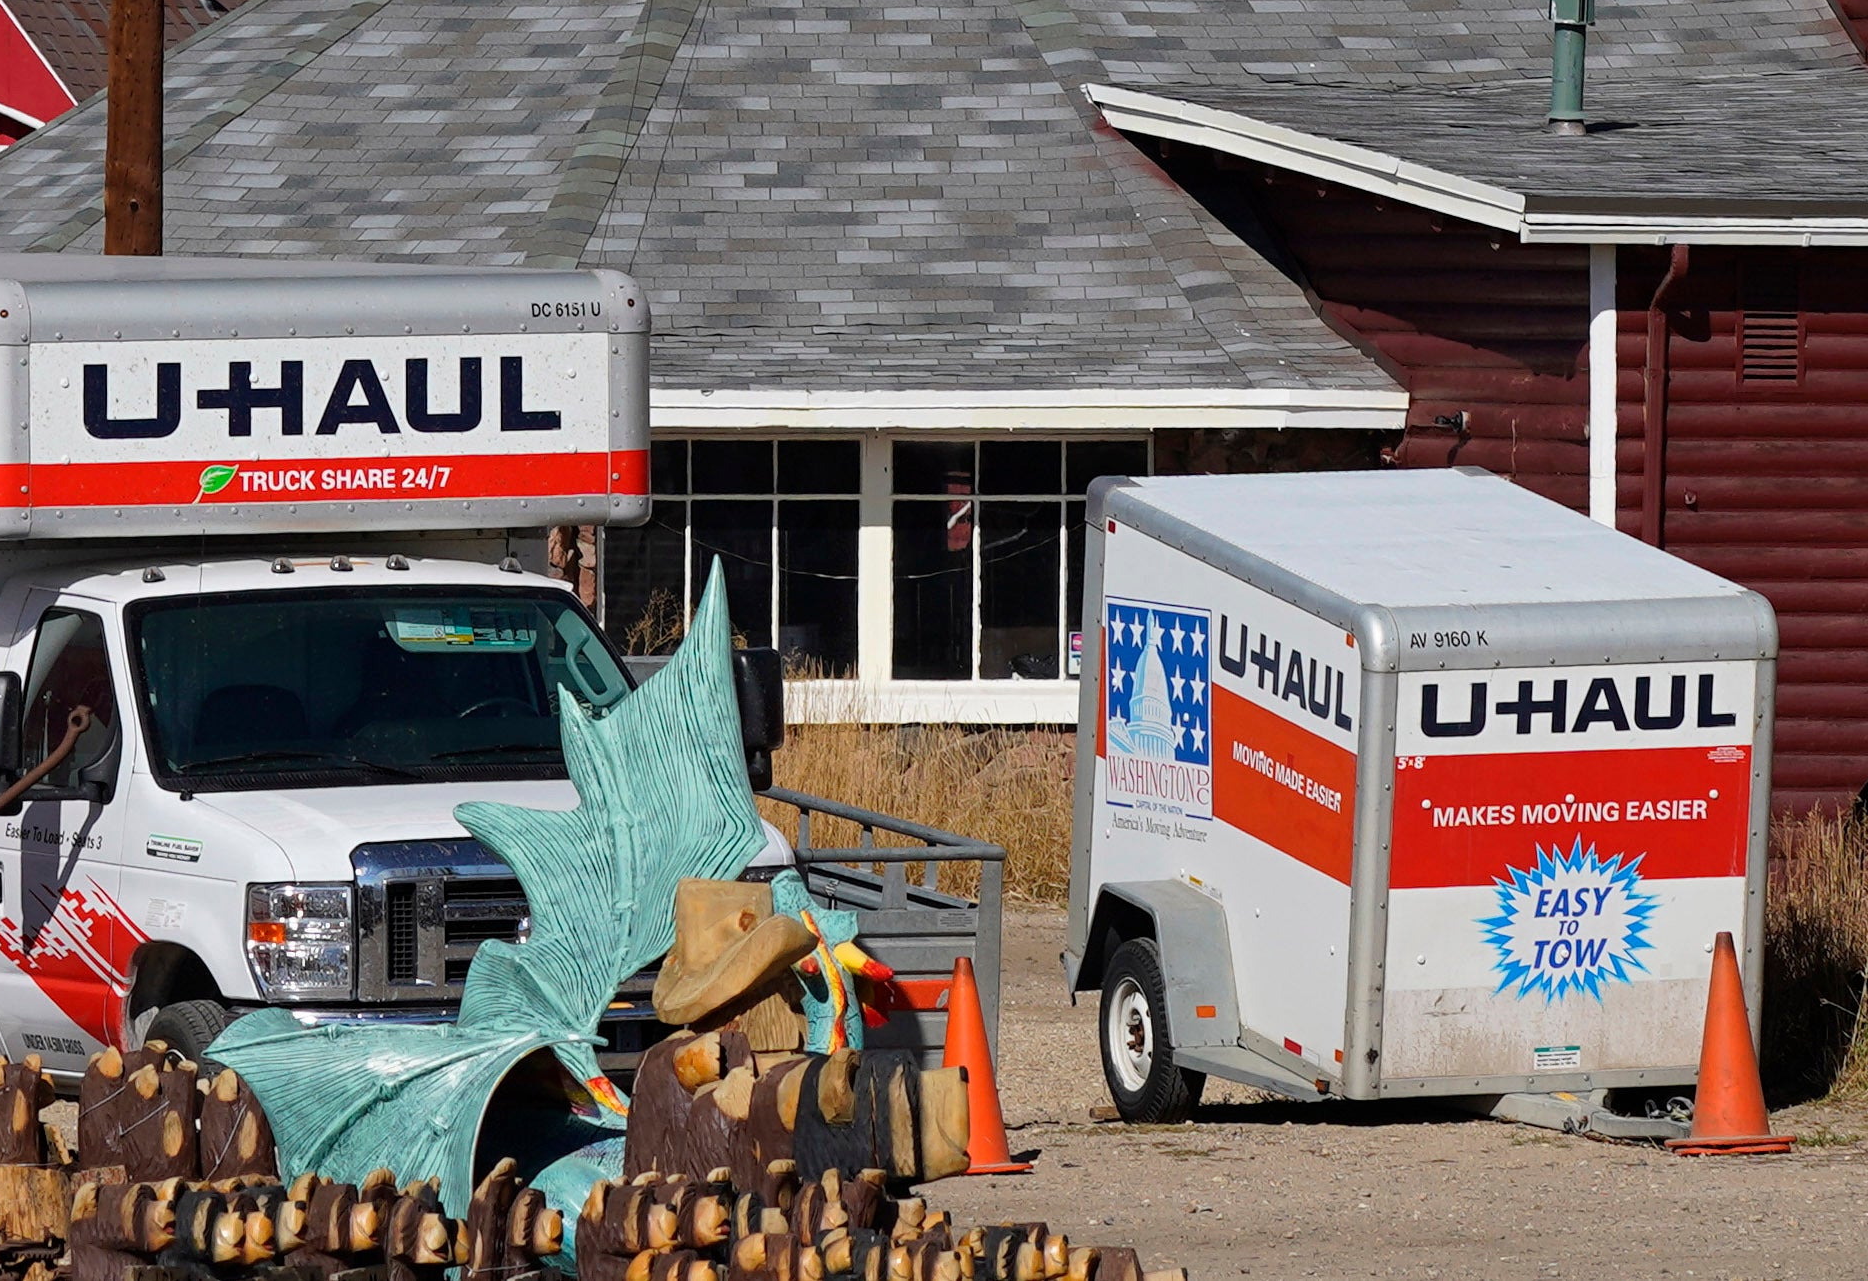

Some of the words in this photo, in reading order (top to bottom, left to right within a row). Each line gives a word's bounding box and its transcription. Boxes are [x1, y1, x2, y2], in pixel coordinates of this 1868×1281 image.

[531, 303, 552, 317] DC
[556, 302, 586, 317] 6151
[591, 302, 601, 316] U
[83, 357, 561, 440] U-HAUL
[238, 469, 316, 492] TRUCK
[321, 467, 396, 490] SHARE
[401, 465, 451, 490] 24/7
[1410, 631, 1428, 649] AV
[1434, 630, 1471, 648] 9160
[1476, 629, 1489, 646] K
[1219, 614, 1353, 733] U-HAUL
[1421, 673, 1737, 738] U-HAUL
[1108, 755, 1195, 803] WASHINGTON
[1233, 740, 1274, 778] MOVING
[1275, 761, 1305, 795] MADE
[1306, 778, 1342, 814] EASIER
[1433, 804, 1516, 828] MAKES
[1522, 801, 1620, 826] MOVING
[1625, 799, 1708, 823] EASIER
[5, 822, 31, 839] Easier
[32, 825, 43, 842] To
[43, 827, 65, 846] Load
[72, 831, 94, 850] Seats
[95, 835, 103, 850] 3
[1534, 886, 1614, 919] EASY
[1559, 920, 1580, 936] TO
[1533, 938, 1608, 969] TOW
